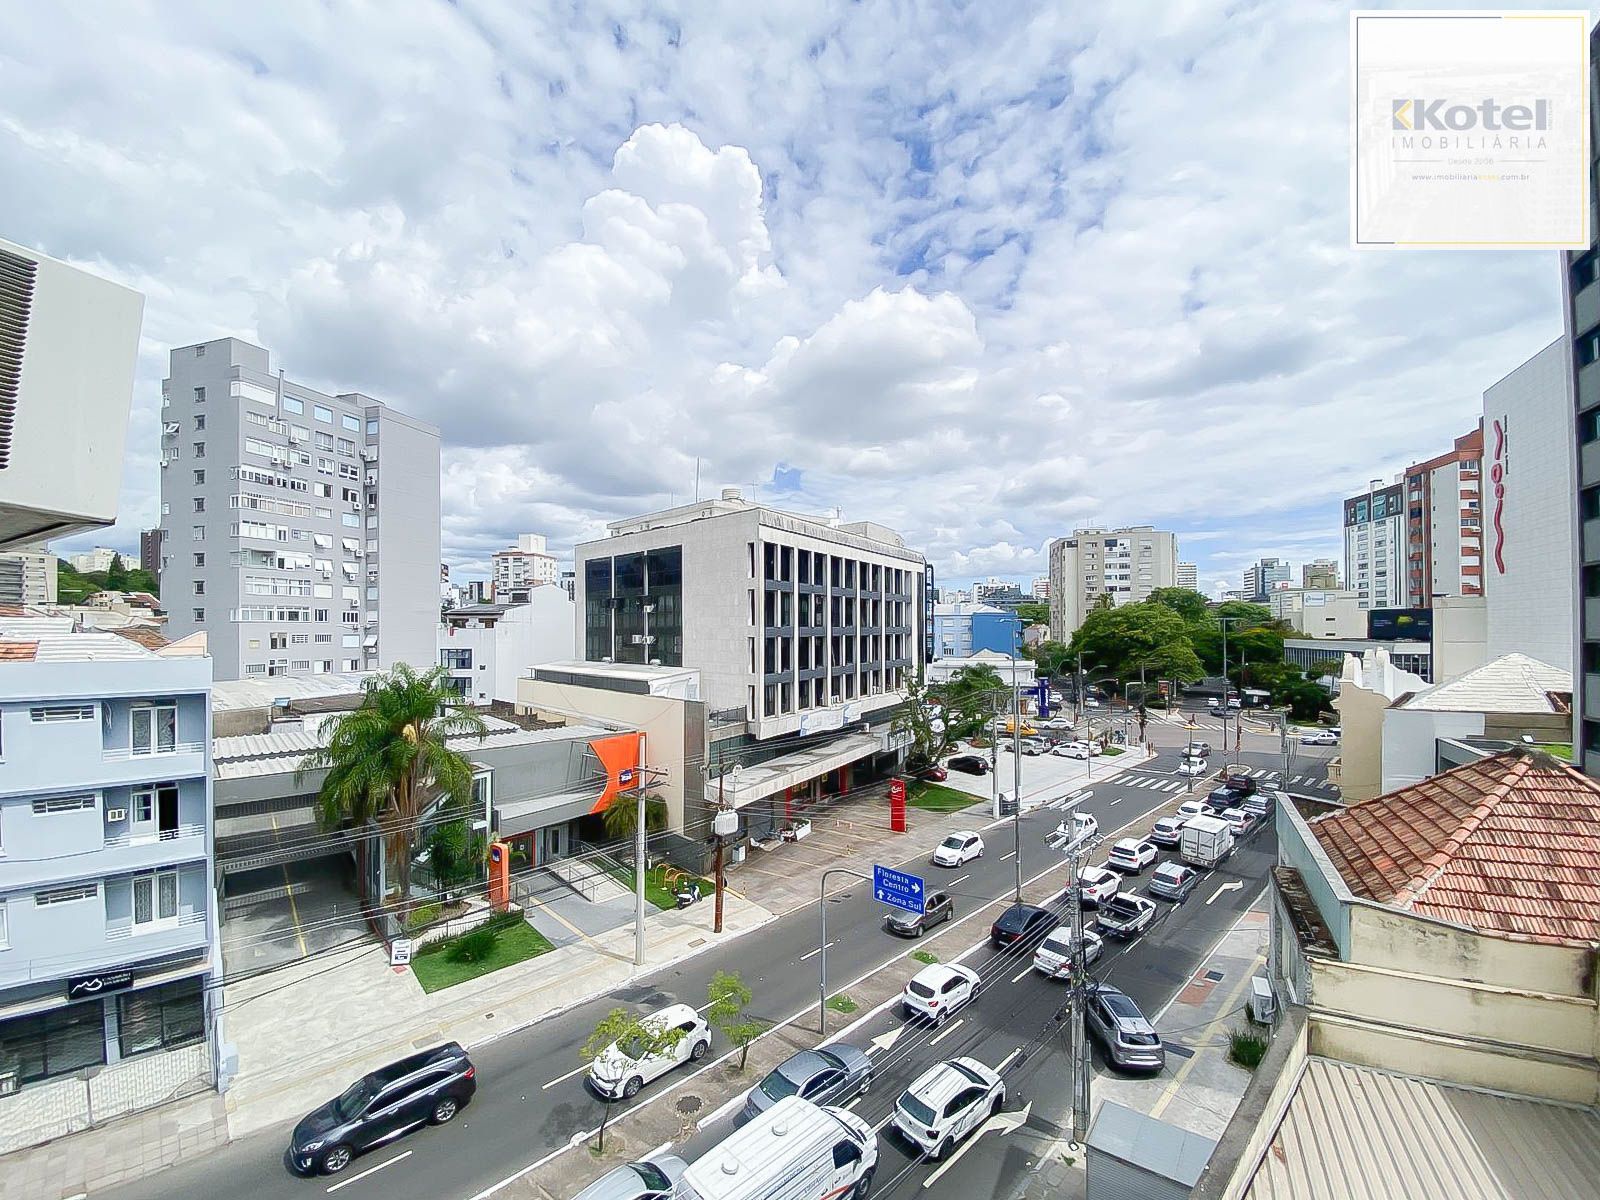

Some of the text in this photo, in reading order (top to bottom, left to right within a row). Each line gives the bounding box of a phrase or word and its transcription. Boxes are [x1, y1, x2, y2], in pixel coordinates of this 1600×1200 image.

[877, 867, 909, 884] Floresta
[882, 878, 909, 893] Centro
[886, 892, 922, 911] Zona Sul
